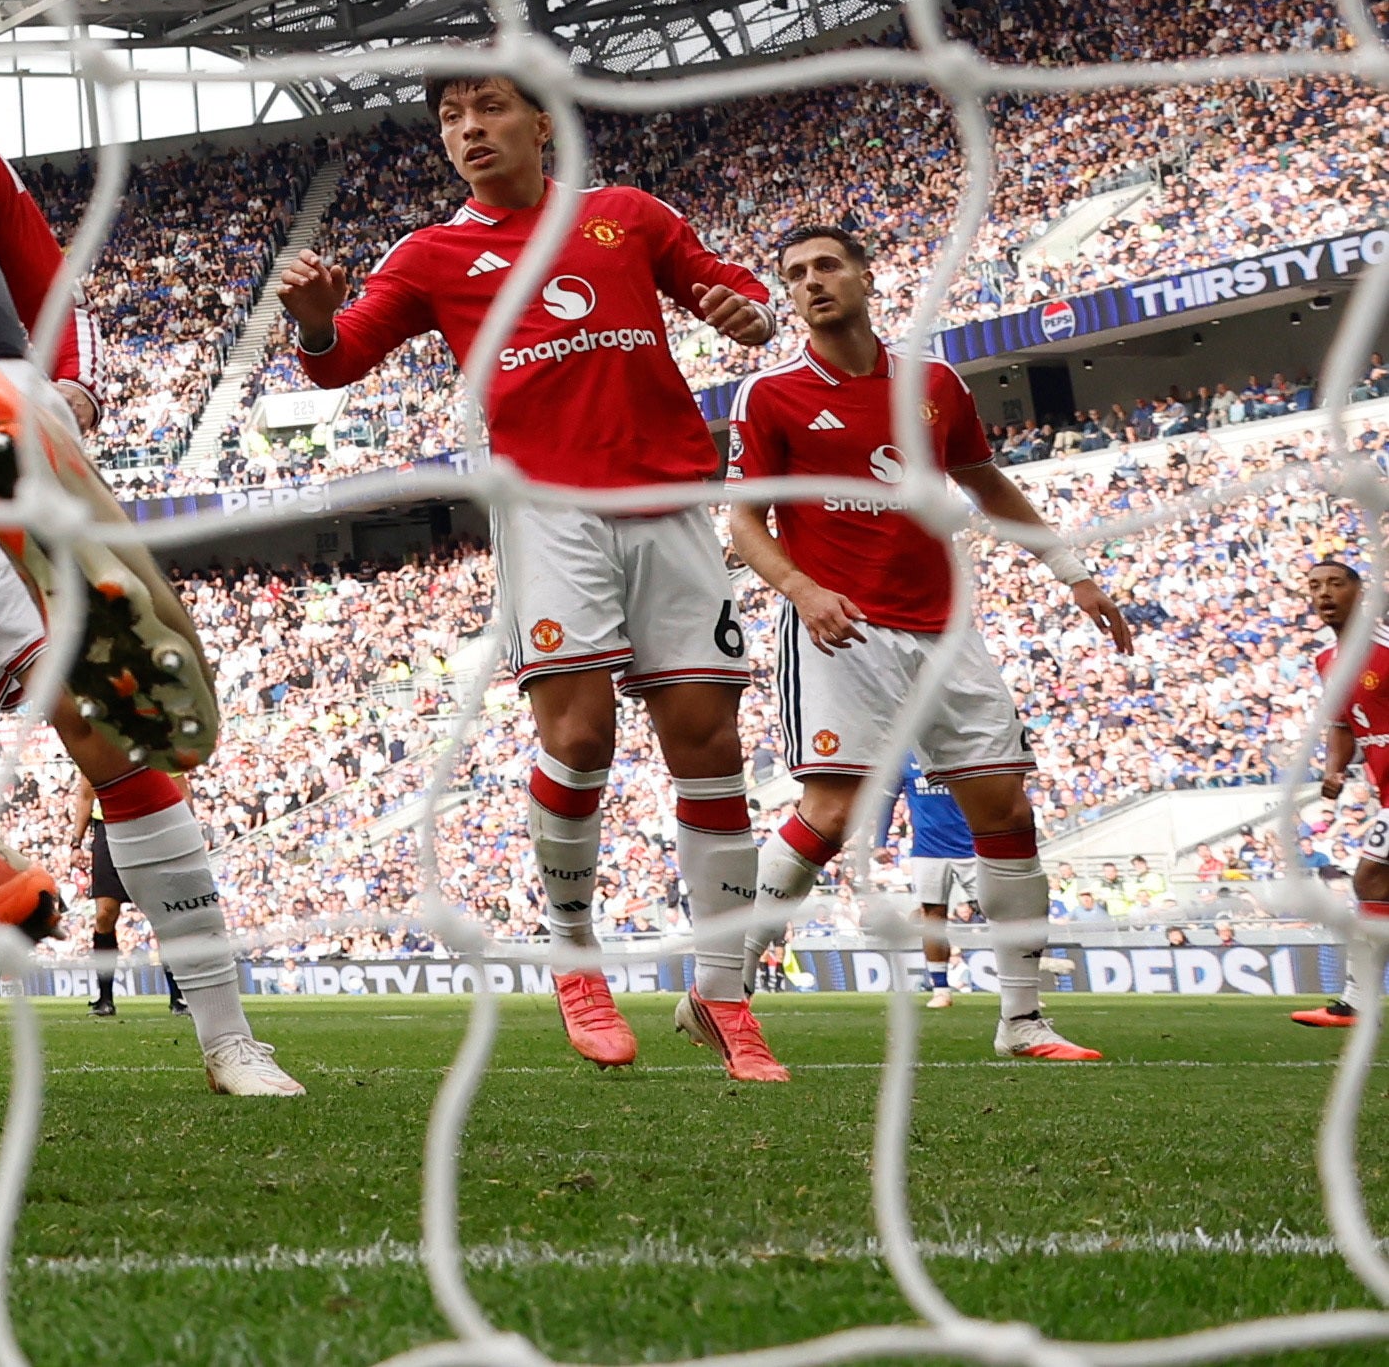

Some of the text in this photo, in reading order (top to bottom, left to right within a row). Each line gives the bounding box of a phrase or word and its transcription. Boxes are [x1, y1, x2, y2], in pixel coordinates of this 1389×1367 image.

[1132, 245, 1324, 317] THIRSTY
[1043, 315, 1073, 330] PEPSI
[499, 328, 657, 371] Snapdragon
[223, 483, 331, 518] PEPSI
[714, 599, 745, 659] 6
[542, 864, 593, 882] MUFC
[426, 964, 513, 994] FOR
[521, 964, 659, 993] MRE
[852, 950, 1000, 994] PES
[1085, 950, 1291, 995] PEPSI
